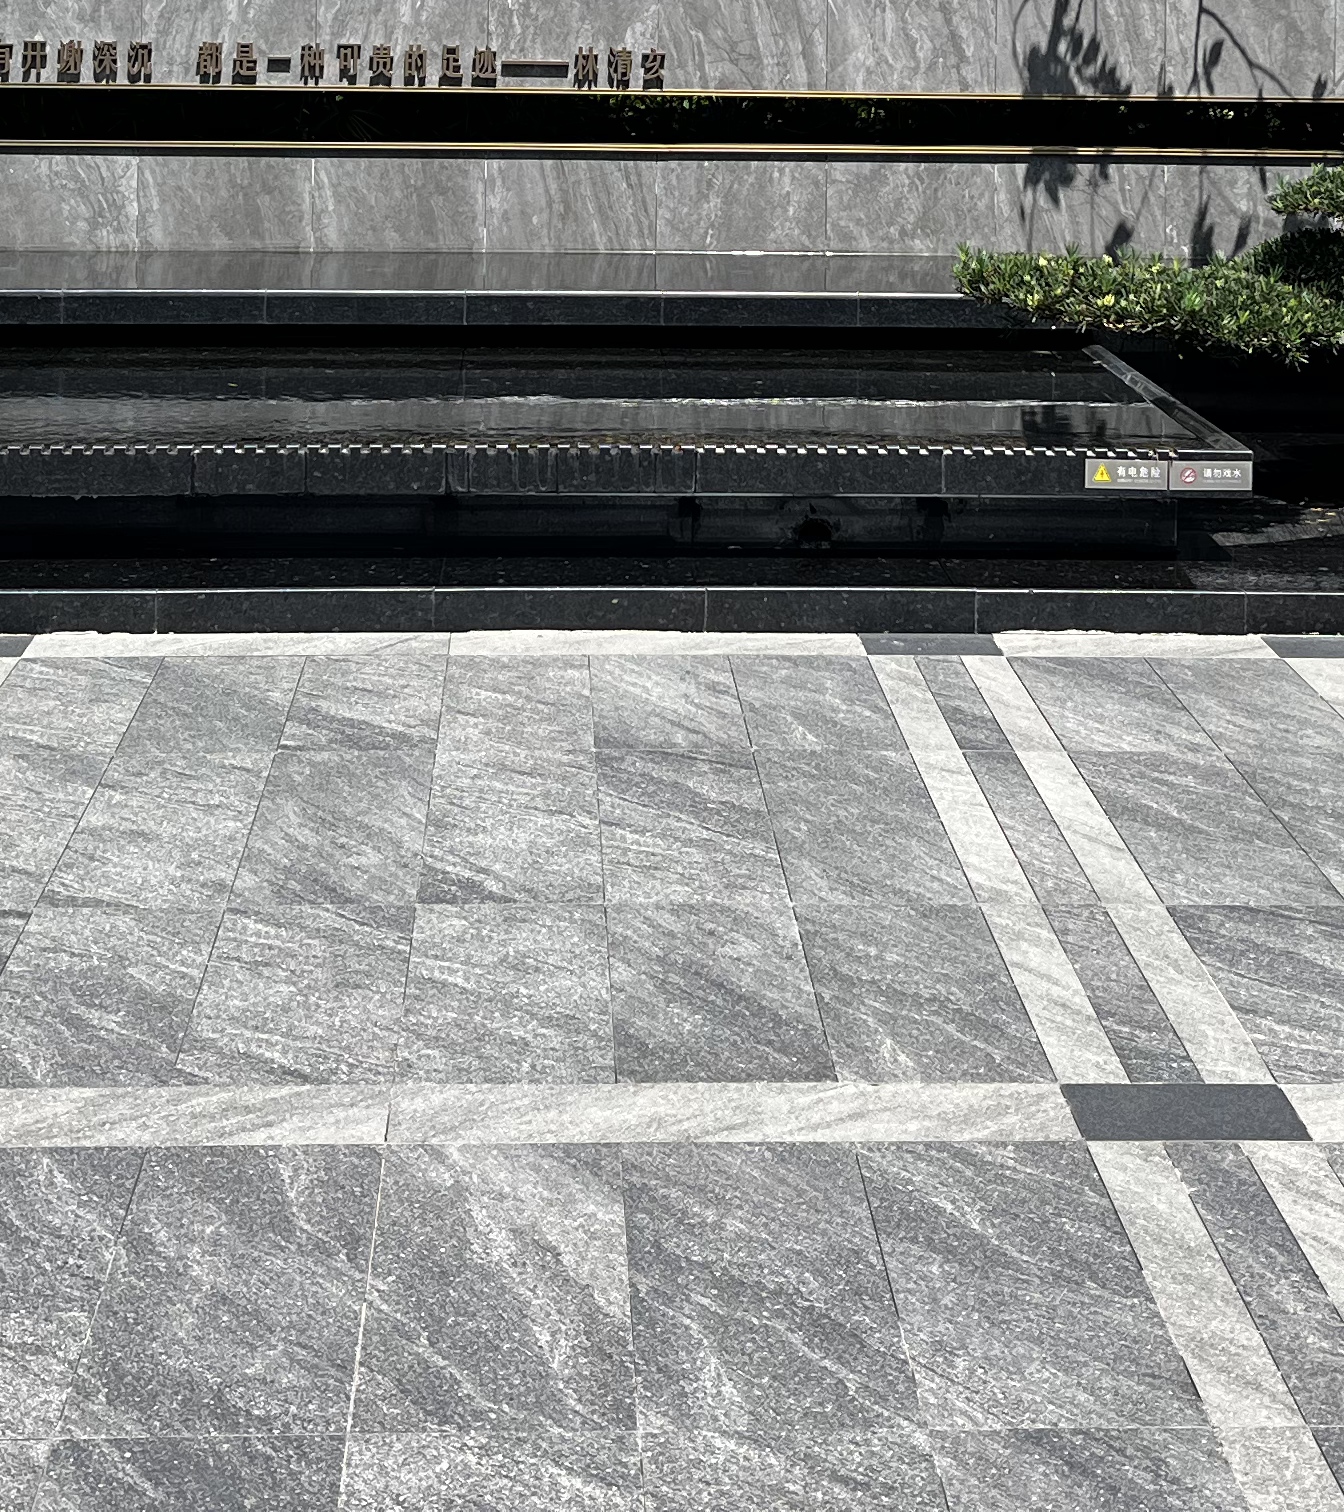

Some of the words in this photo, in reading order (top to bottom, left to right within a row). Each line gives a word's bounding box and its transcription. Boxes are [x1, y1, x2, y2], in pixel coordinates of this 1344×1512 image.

[1116, 465, 1161, 478] 有电危险
[1203, 468, 1242, 478] 请勿戏水
